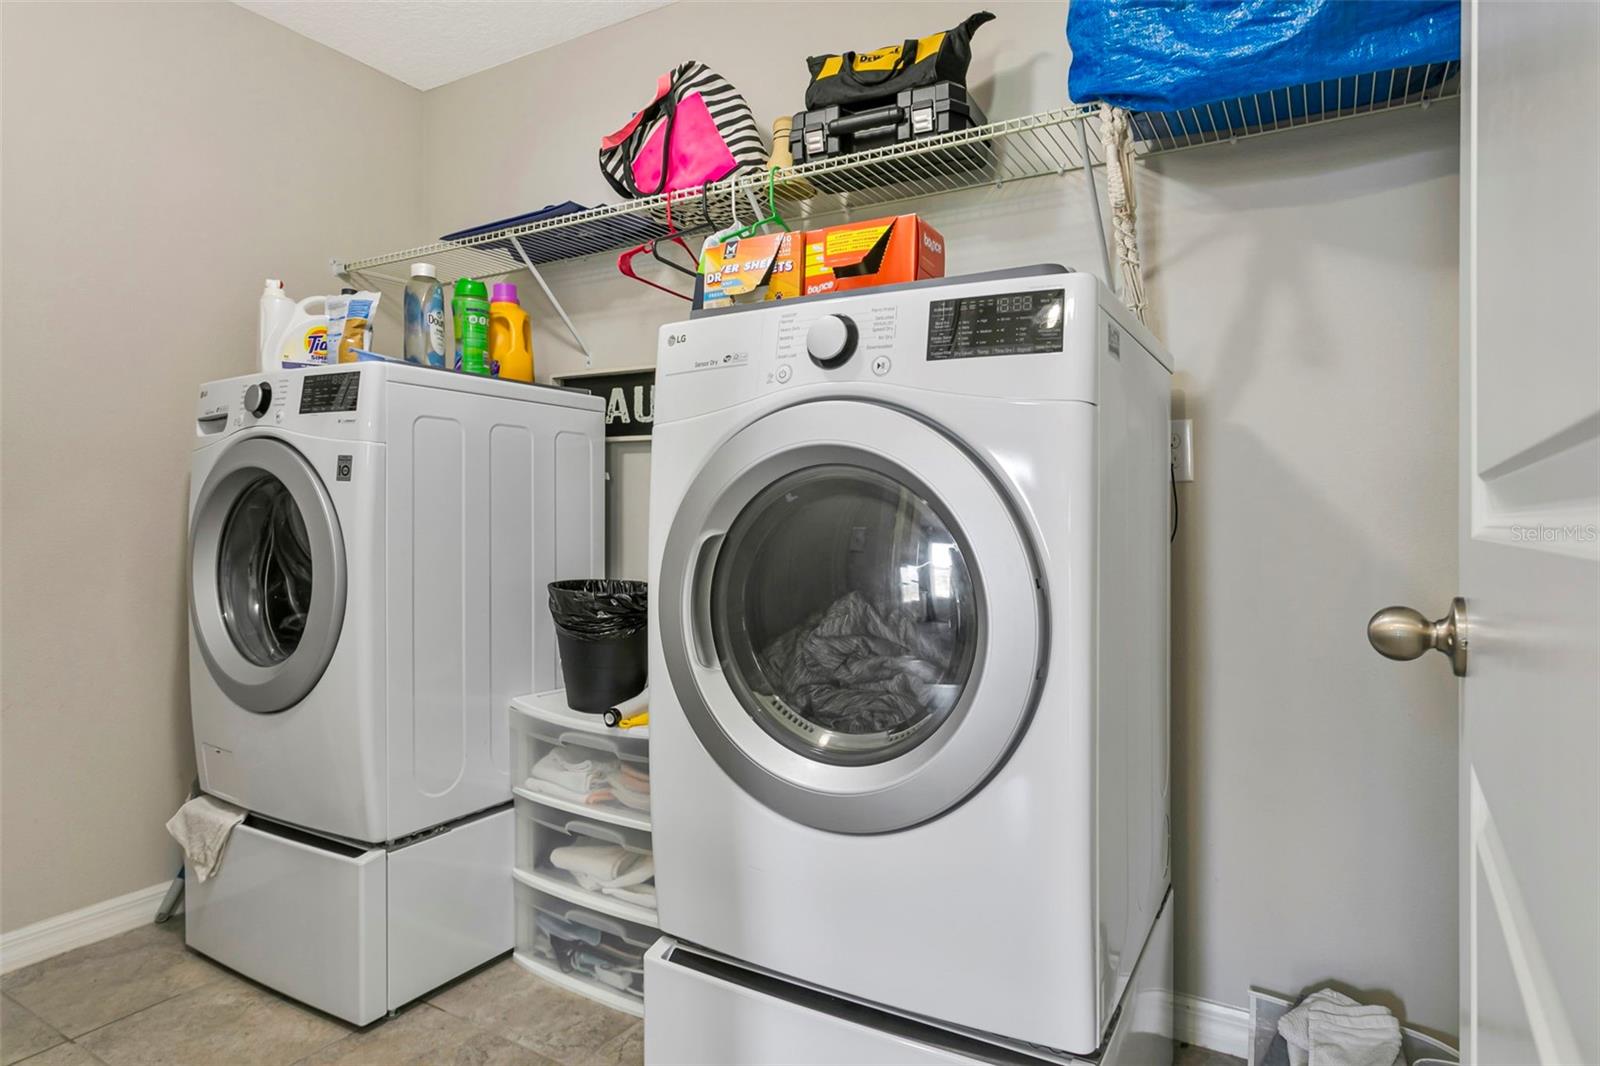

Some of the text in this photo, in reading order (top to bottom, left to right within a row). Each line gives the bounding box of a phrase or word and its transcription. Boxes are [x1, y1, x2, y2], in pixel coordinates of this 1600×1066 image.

[807, 280, 834, 294] bounce
[308, 335, 328, 354] Tid
[605, 384, 655, 424] AU
